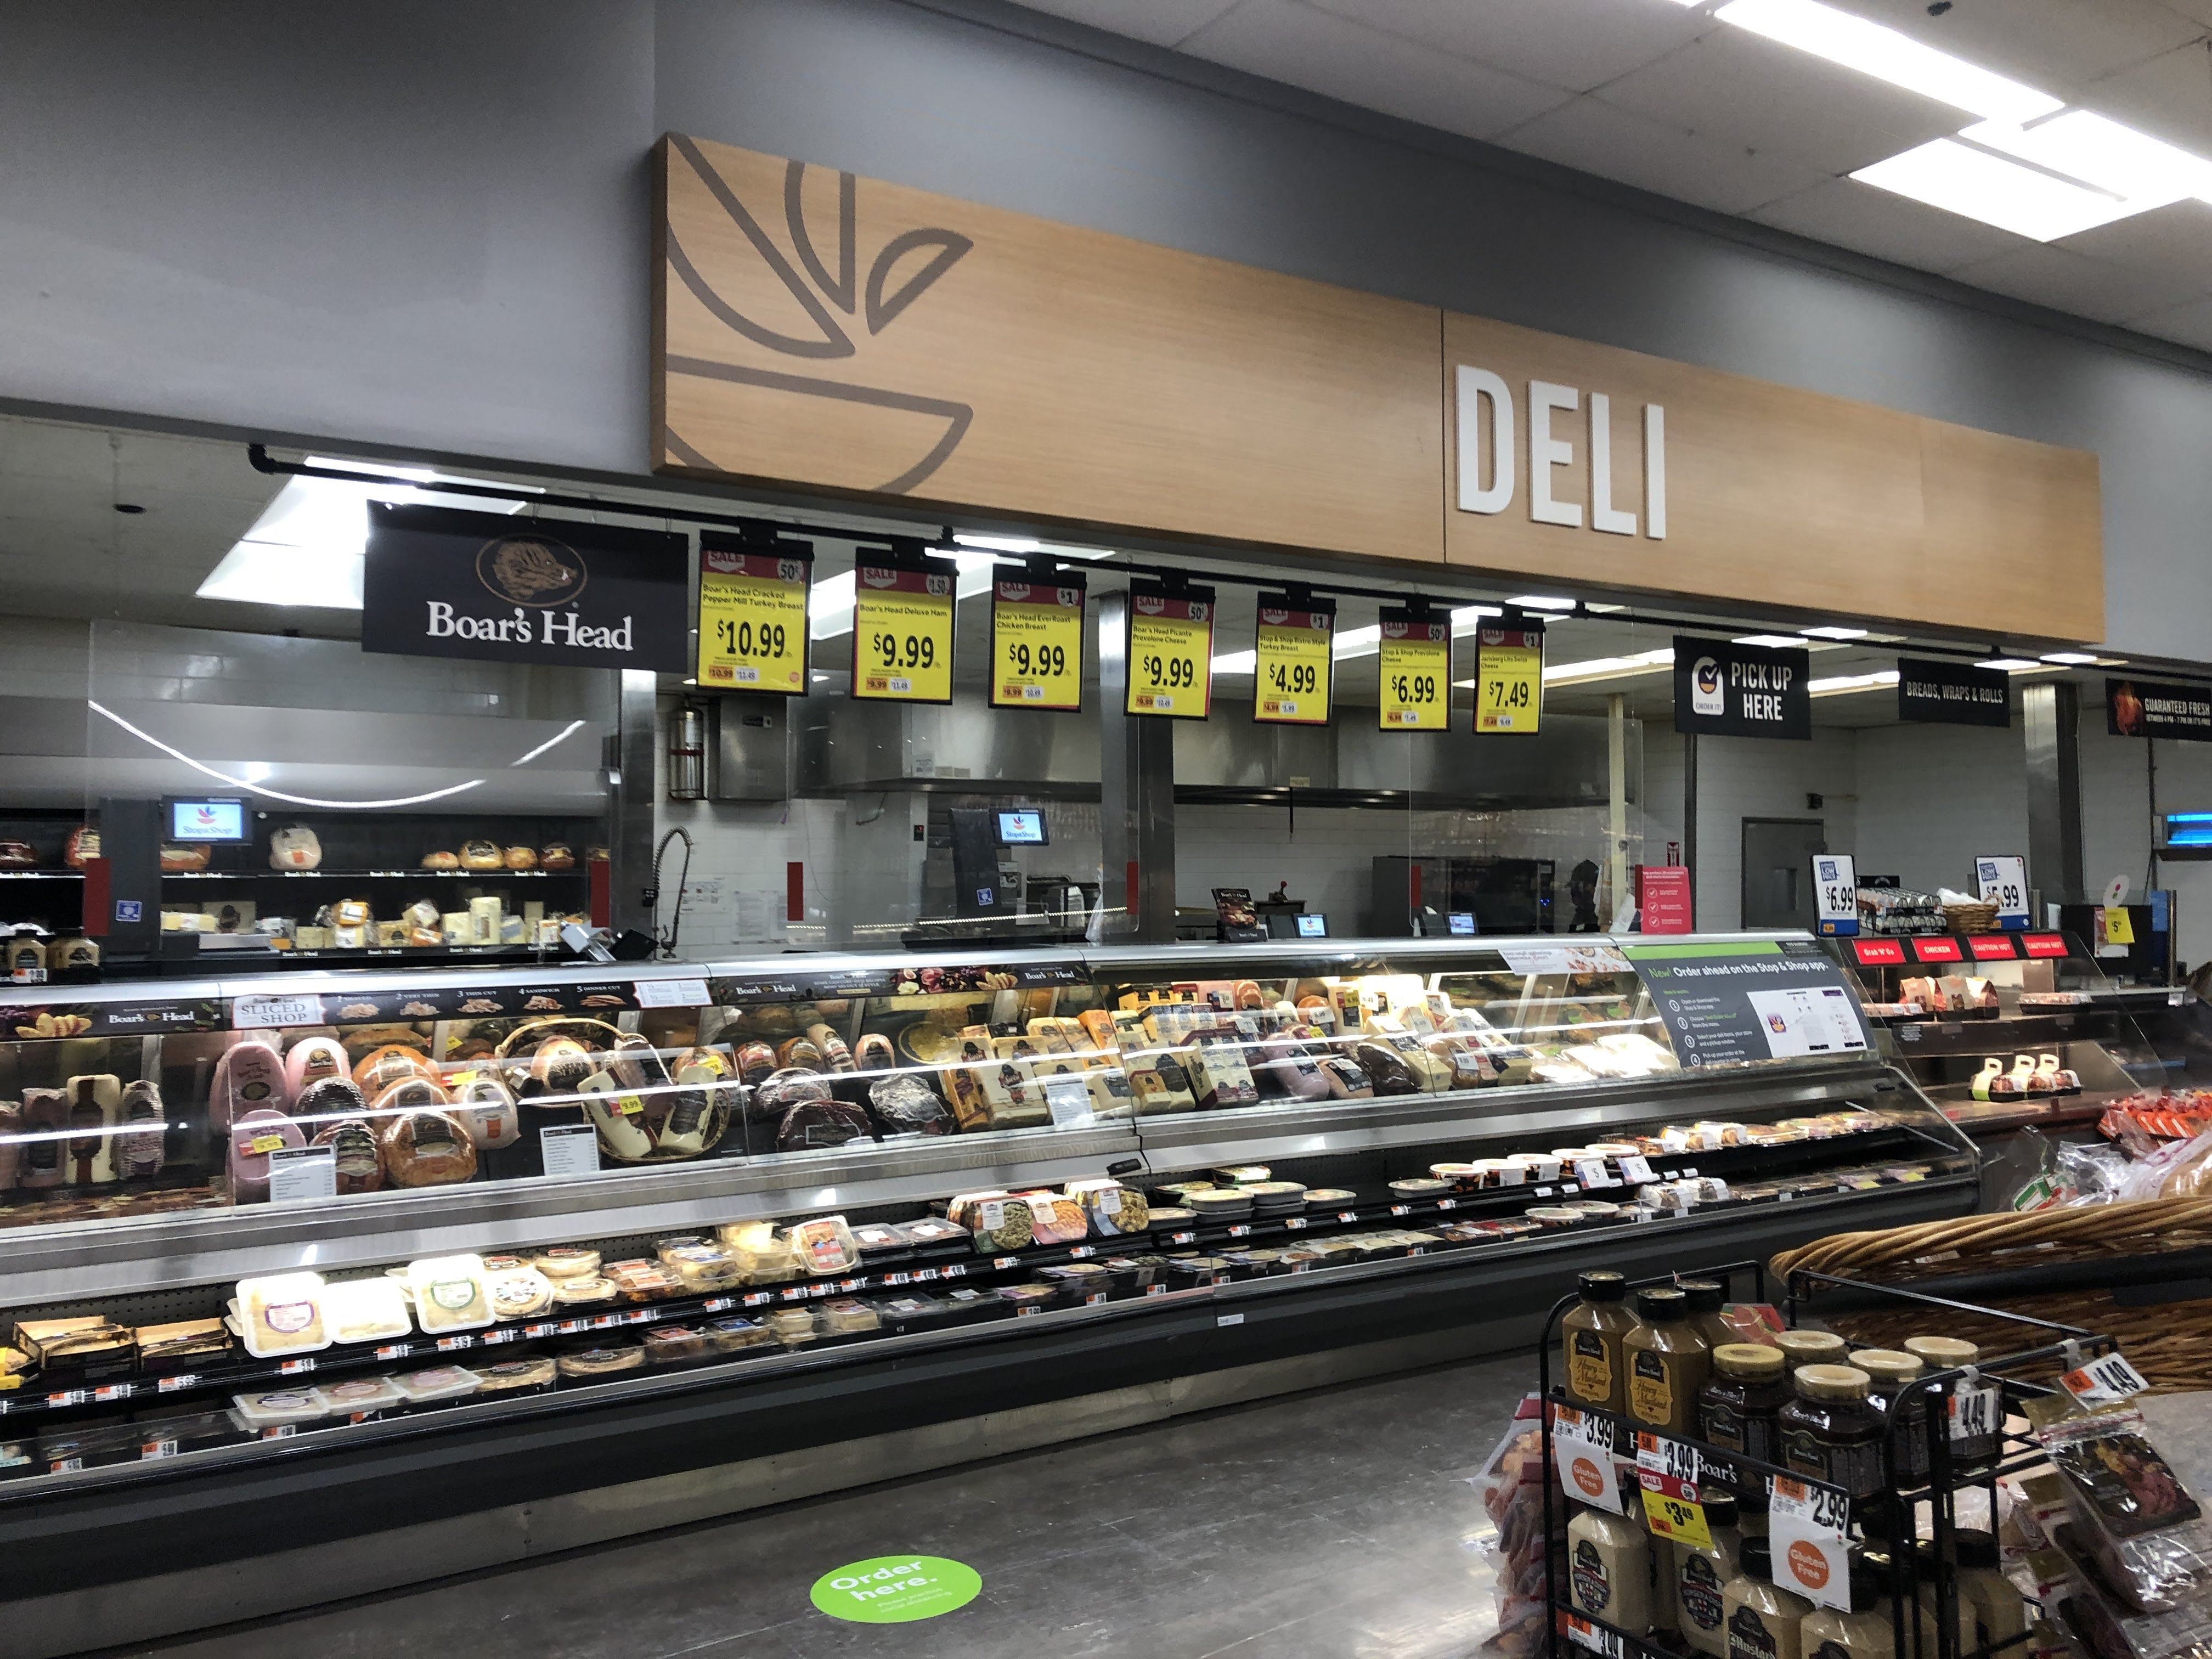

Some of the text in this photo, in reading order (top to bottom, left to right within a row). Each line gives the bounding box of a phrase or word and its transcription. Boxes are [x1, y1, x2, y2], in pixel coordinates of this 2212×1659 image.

[1456, 364, 1666, 540] DELI
[710, 551, 742, 563] SALE
[866, 569, 895, 580] SALE
[703, 584, 785, 599] Boar's Head Cracked
[1002, 583, 1029, 592] SALE
[703, 594, 731, 605] Pepper
[733, 597, 747, 605] Mill
[749, 599, 776, 608] Turkey
[1138, 596, 1163, 607] SALE
[860, 604, 883, 613] Boar's
[905, 607, 929, 616] Deluxe
[930, 609, 947, 617] Ham
[996, 612, 1017, 620] Boar's
[426, 601, 633, 651] Boar's Head
[1133, 625, 1153, 633] Boar's
[1170, 628, 1192, 637] Picante
[718, 618, 785, 658] $10.99
[1133, 634, 1164, 643] Provolone
[1279, 636, 1293, 645] Shop
[1312, 637, 1325, 646] Style
[874, 633, 934, 669] $9.99
[1009, 642, 1064, 676] $9.99
[1143, 654, 1193, 688] $9.99
[1269, 663, 1315, 694] $4.99
[1731, 662, 1793, 691] PICK UP
[1392, 675, 1435, 703] $6.99
[1489, 679, 1528, 708] $7.49
[1906, 681, 2003, 704] BREADS, WRAPS & ROLLS
[1743, 693, 1783, 721] HERE
[2145, 697, 2210, 716] GUARANTEED FRESH
[1826, 885, 1853, 911] $6.99
[1864, 948, 1878, 956] Grab
[1647, 961, 1829, 979] New! Order ahead on the Stop & Shop app.
[736, 984, 797, 996] Boar's Head
[109, 1011, 194, 1024] Boar's Head
[241, 1004, 306, 1015] SLICED
[261, 1013, 308, 1024] SHOP
[1584, 1412, 1613, 1449] $3.99
[1664, 1441, 1694, 1482] $3.99
[1697, 1454, 1737, 1483] Boar's
[1573, 1464, 1601, 1481] Gluten
[1641, 1475, 1661, 1487] SALE
[1580, 1476, 1598, 1489] Free
[1810, 1487, 1848, 1531] $2.99
[831, 1561, 922, 1590] Order
[1797, 1563, 1820, 1579] Free
[850, 1577, 938, 1601] here.
